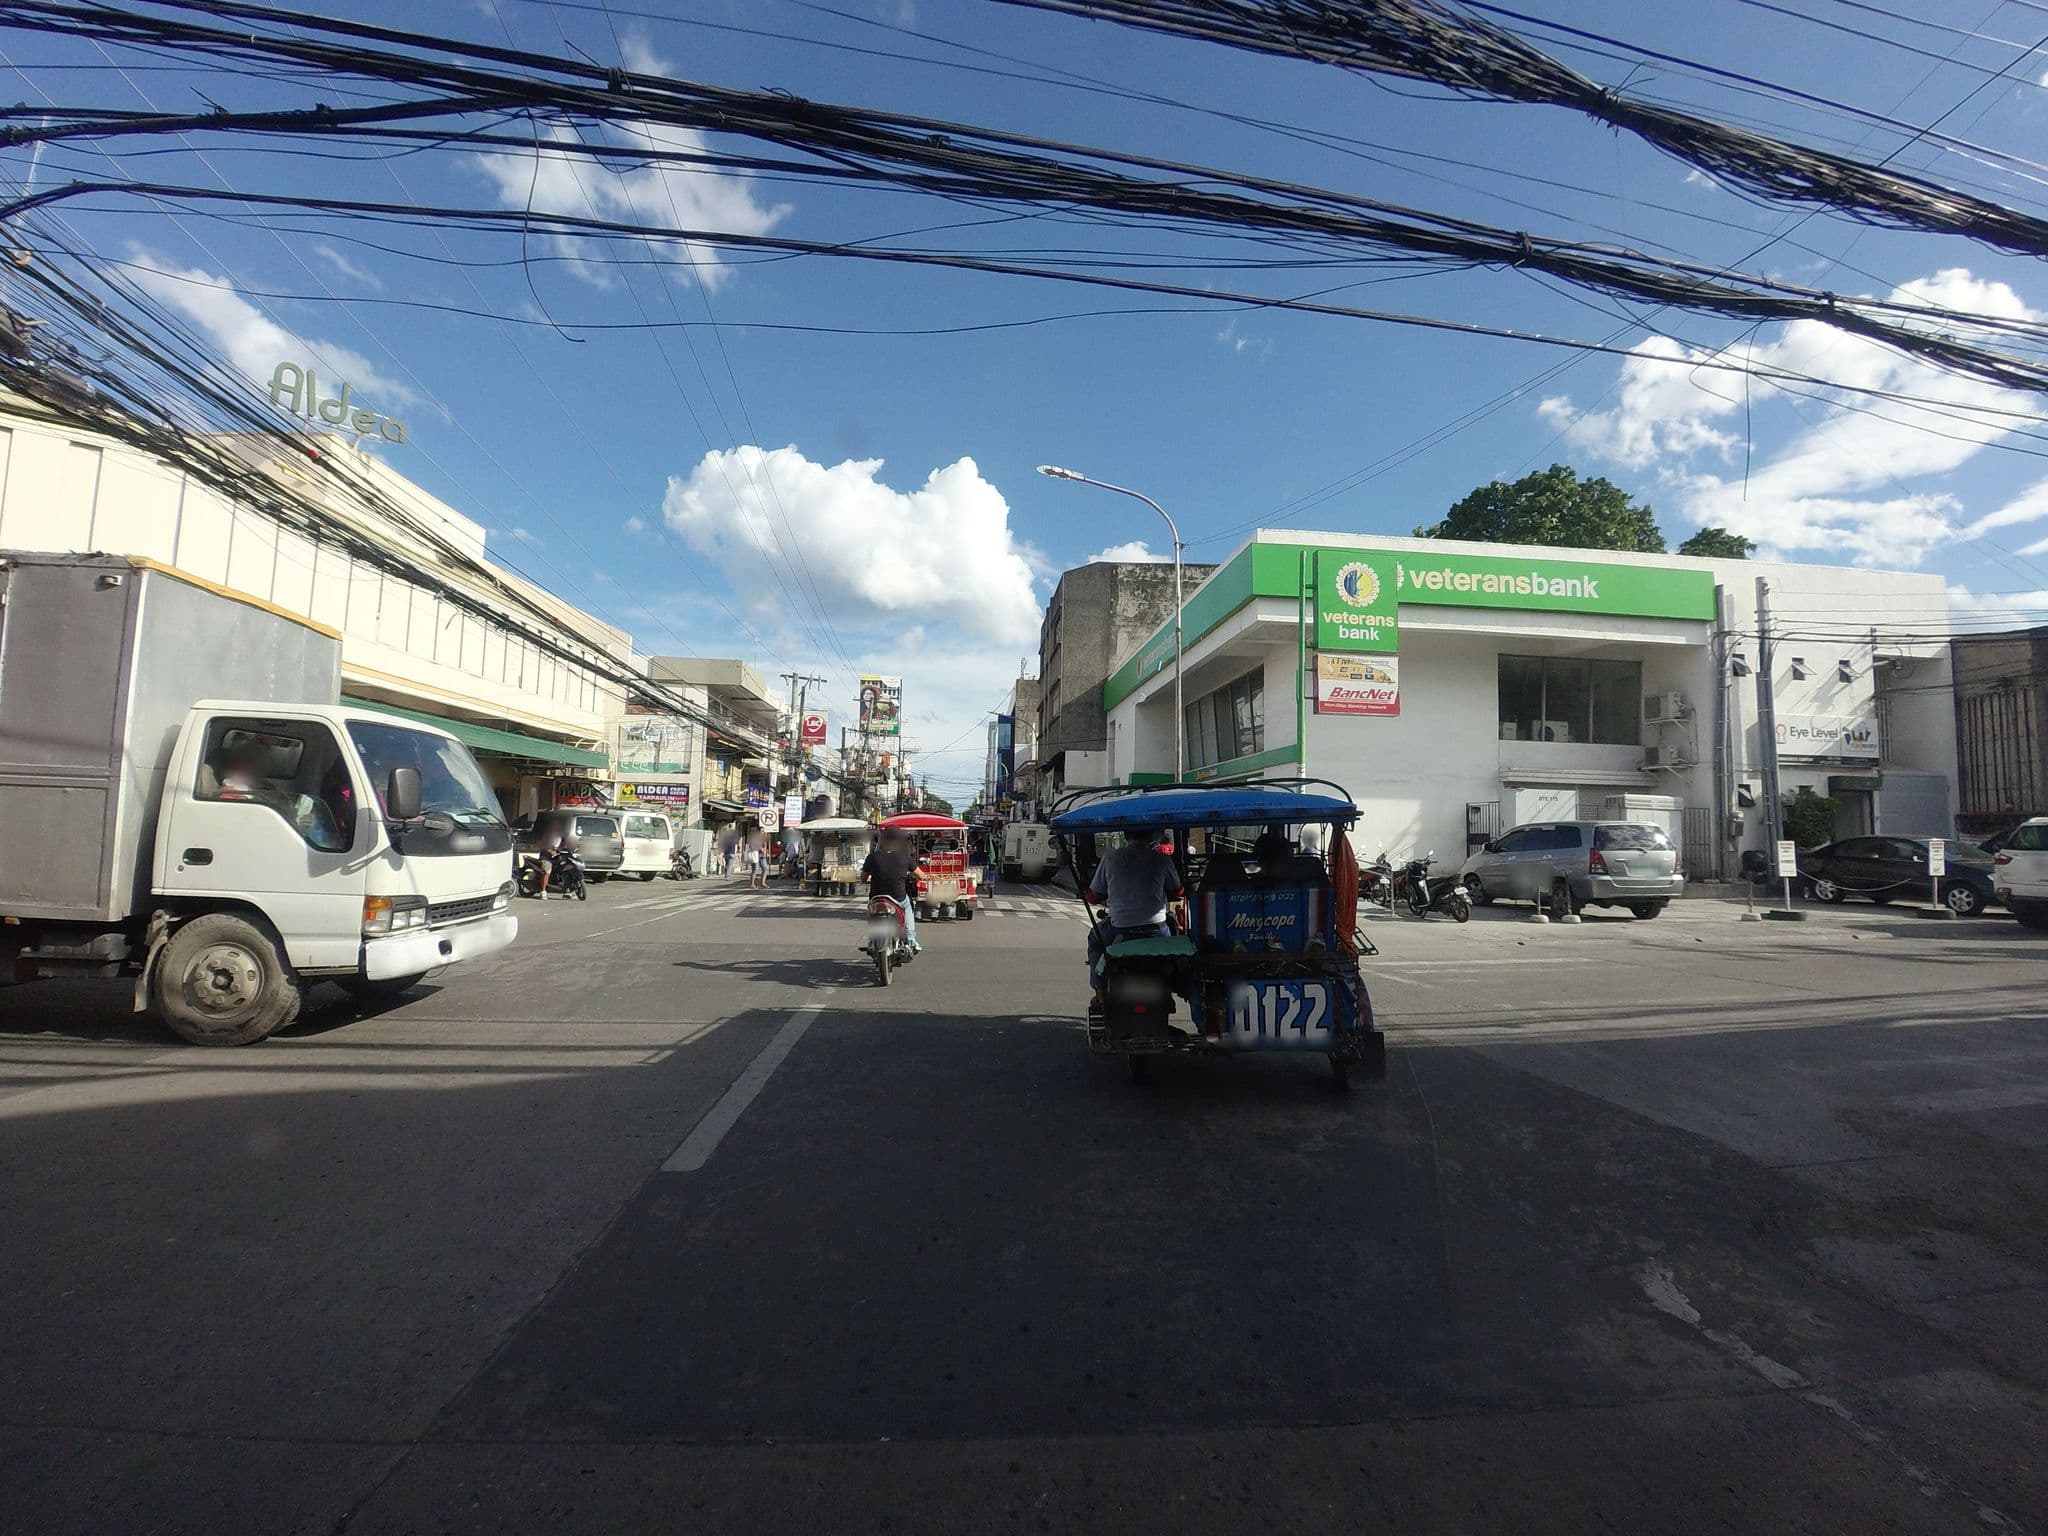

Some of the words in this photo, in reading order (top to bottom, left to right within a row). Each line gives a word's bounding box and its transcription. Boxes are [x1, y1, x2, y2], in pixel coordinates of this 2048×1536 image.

[267, 361, 406, 444] Aldea
[1408, 567, 1600, 600] veteransbank
[1323, 610, 1395, 628] veterans
[1338, 625, 1380, 641] bank
[1330, 686, 1395, 700] BancNet
[1790, 726, 1809, 739] Eye
[1811, 727, 1839, 739] Level
